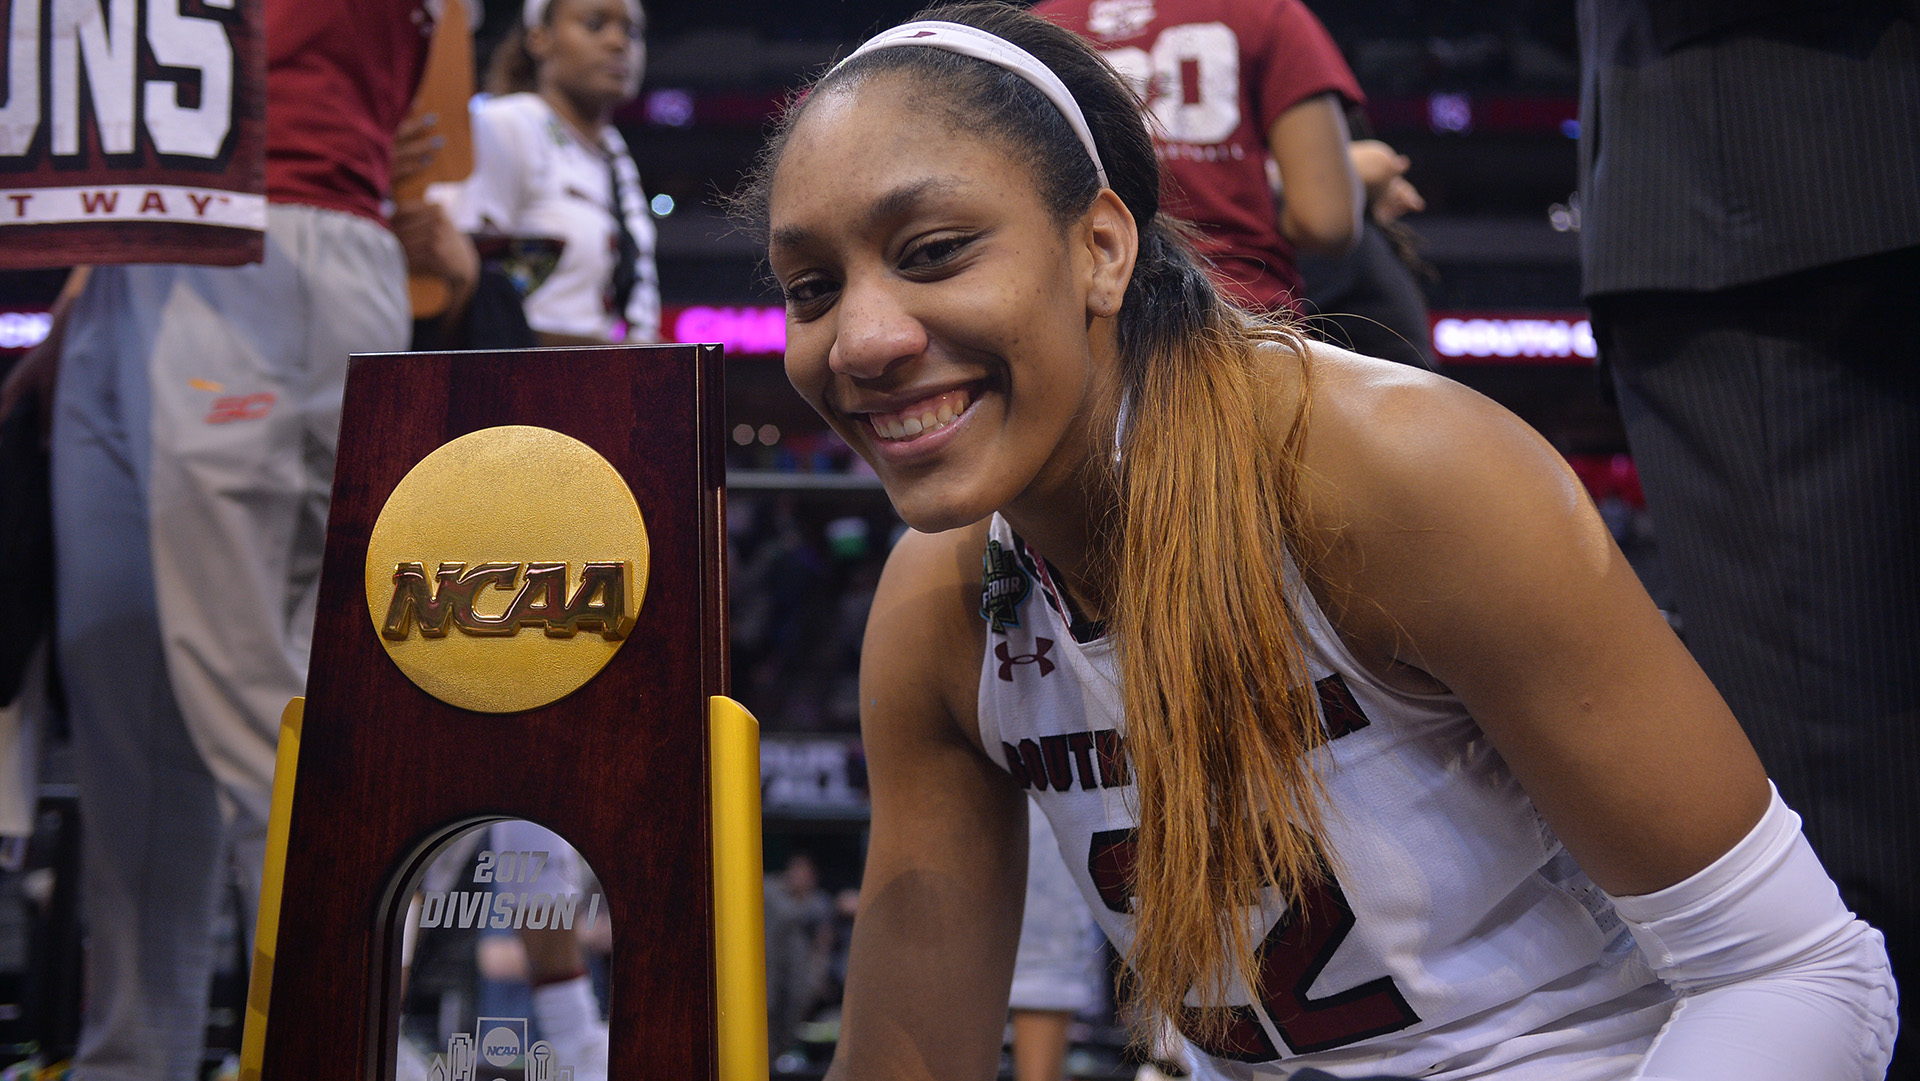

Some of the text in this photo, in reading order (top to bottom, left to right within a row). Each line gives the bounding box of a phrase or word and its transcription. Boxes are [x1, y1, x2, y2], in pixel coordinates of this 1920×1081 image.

[81, 191, 212, 216] WAY
[381, 560, 637, 641] NCAA
[1002, 728, 1131, 792] SOUTH
[473, 850, 549, 883] 2017
[419, 891, 600, 930] DIVISION I
[486, 1045, 518, 1057] NCAA
